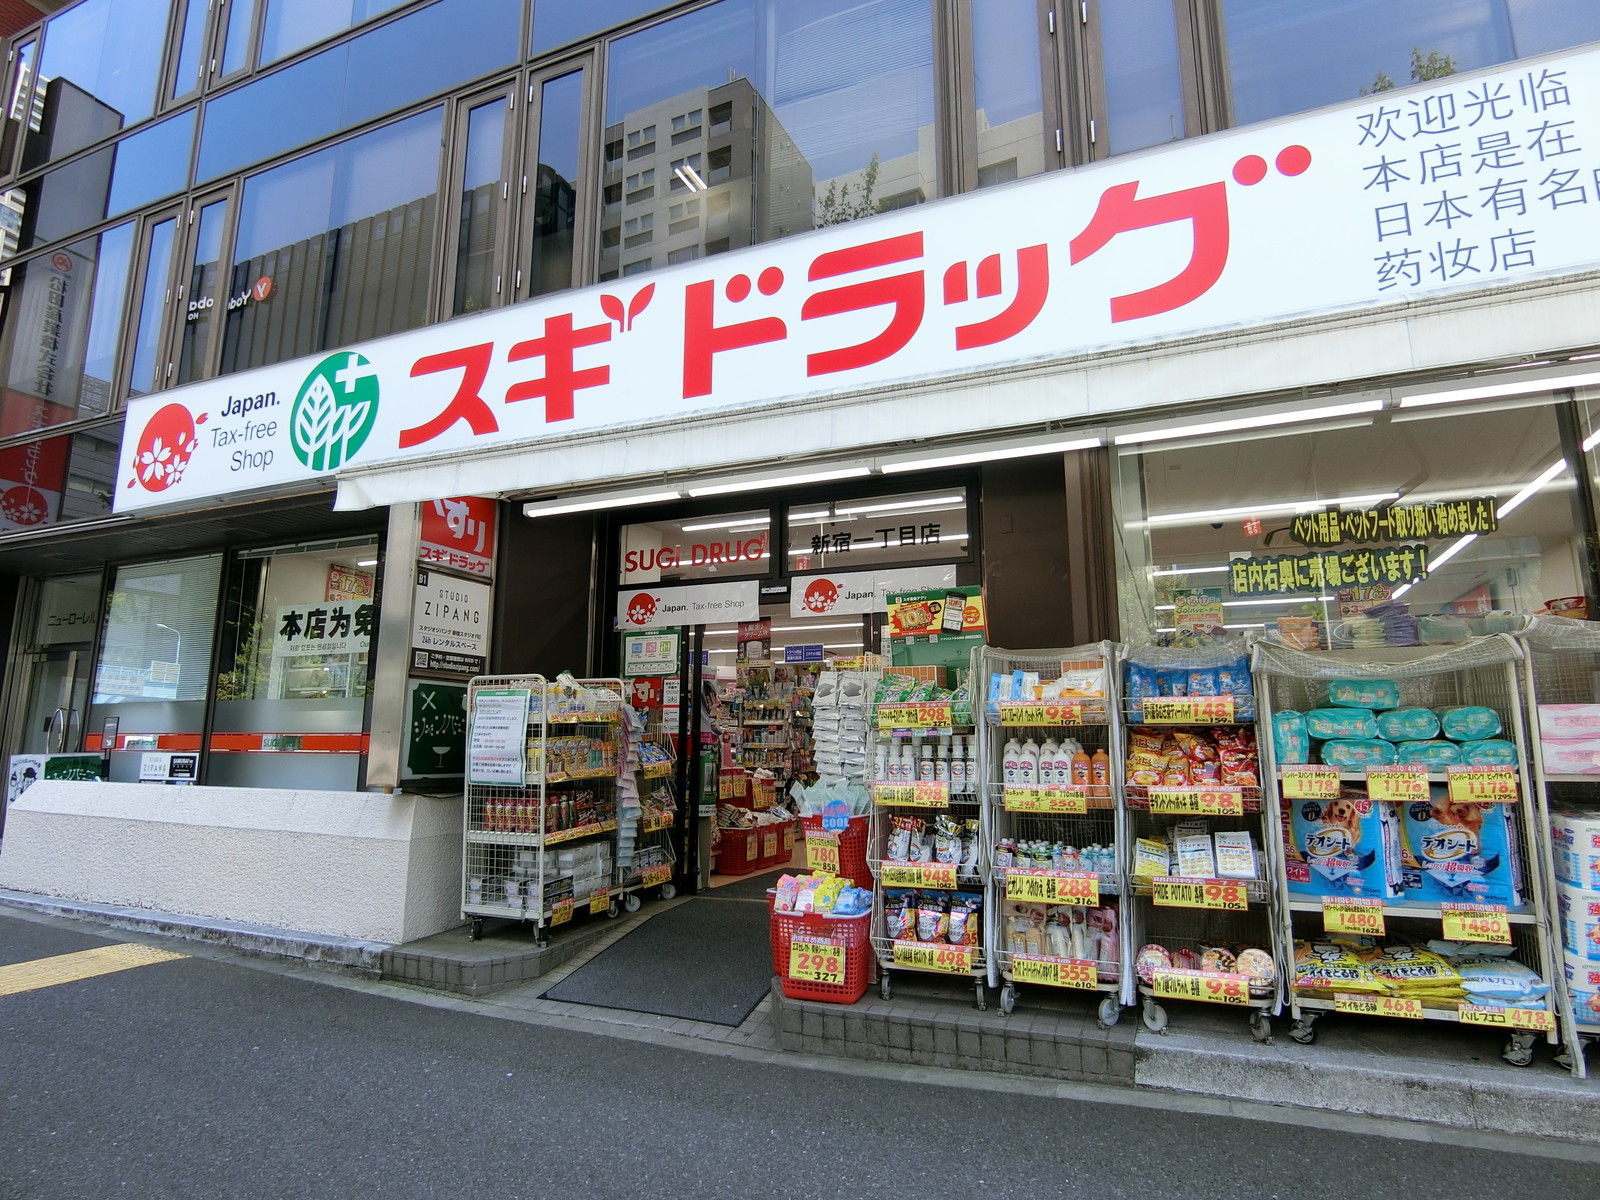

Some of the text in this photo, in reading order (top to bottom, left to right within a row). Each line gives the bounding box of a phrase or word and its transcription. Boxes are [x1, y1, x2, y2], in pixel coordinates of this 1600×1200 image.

[1356, 69, 1571, 147] 欢迎光临
[1363, 120, 1582, 193] 本店是在
[1374, 227, 1536, 291] 药妆店
[399, 145, 1312, 449] スギドラッグ
[221, 390, 281, 418] Japan.
[211, 419, 278, 449] Tax-free
[230, 449, 274, 472] Shop
[811, 523, 941, 554] 新宿一丁目店
[420, 545, 490, 573] スギドラッグ
[625, 538, 765, 573] SUGI DRUG
[418, 573, 426, 585] B1
[1232, 547, 1428, 594] 店内右奥に売場ございます！
[439, 589, 469, 603] STUDIO
[845, 590, 876, 600] Japan.
[47, 608, 96, 627] ニューローレル
[424, 601, 480, 624] ZIPANG
[662, 600, 745, 614] Japan. Tax-free Shop
[1306, 834, 1351, 849] デオシート
[1421, 837, 1477, 852] デオシート
[1287, 867, 1305, 875] ワイド
[1154, 884, 1169, 900] PRIDE
[1171, 885, 1192, 901] POTATO
